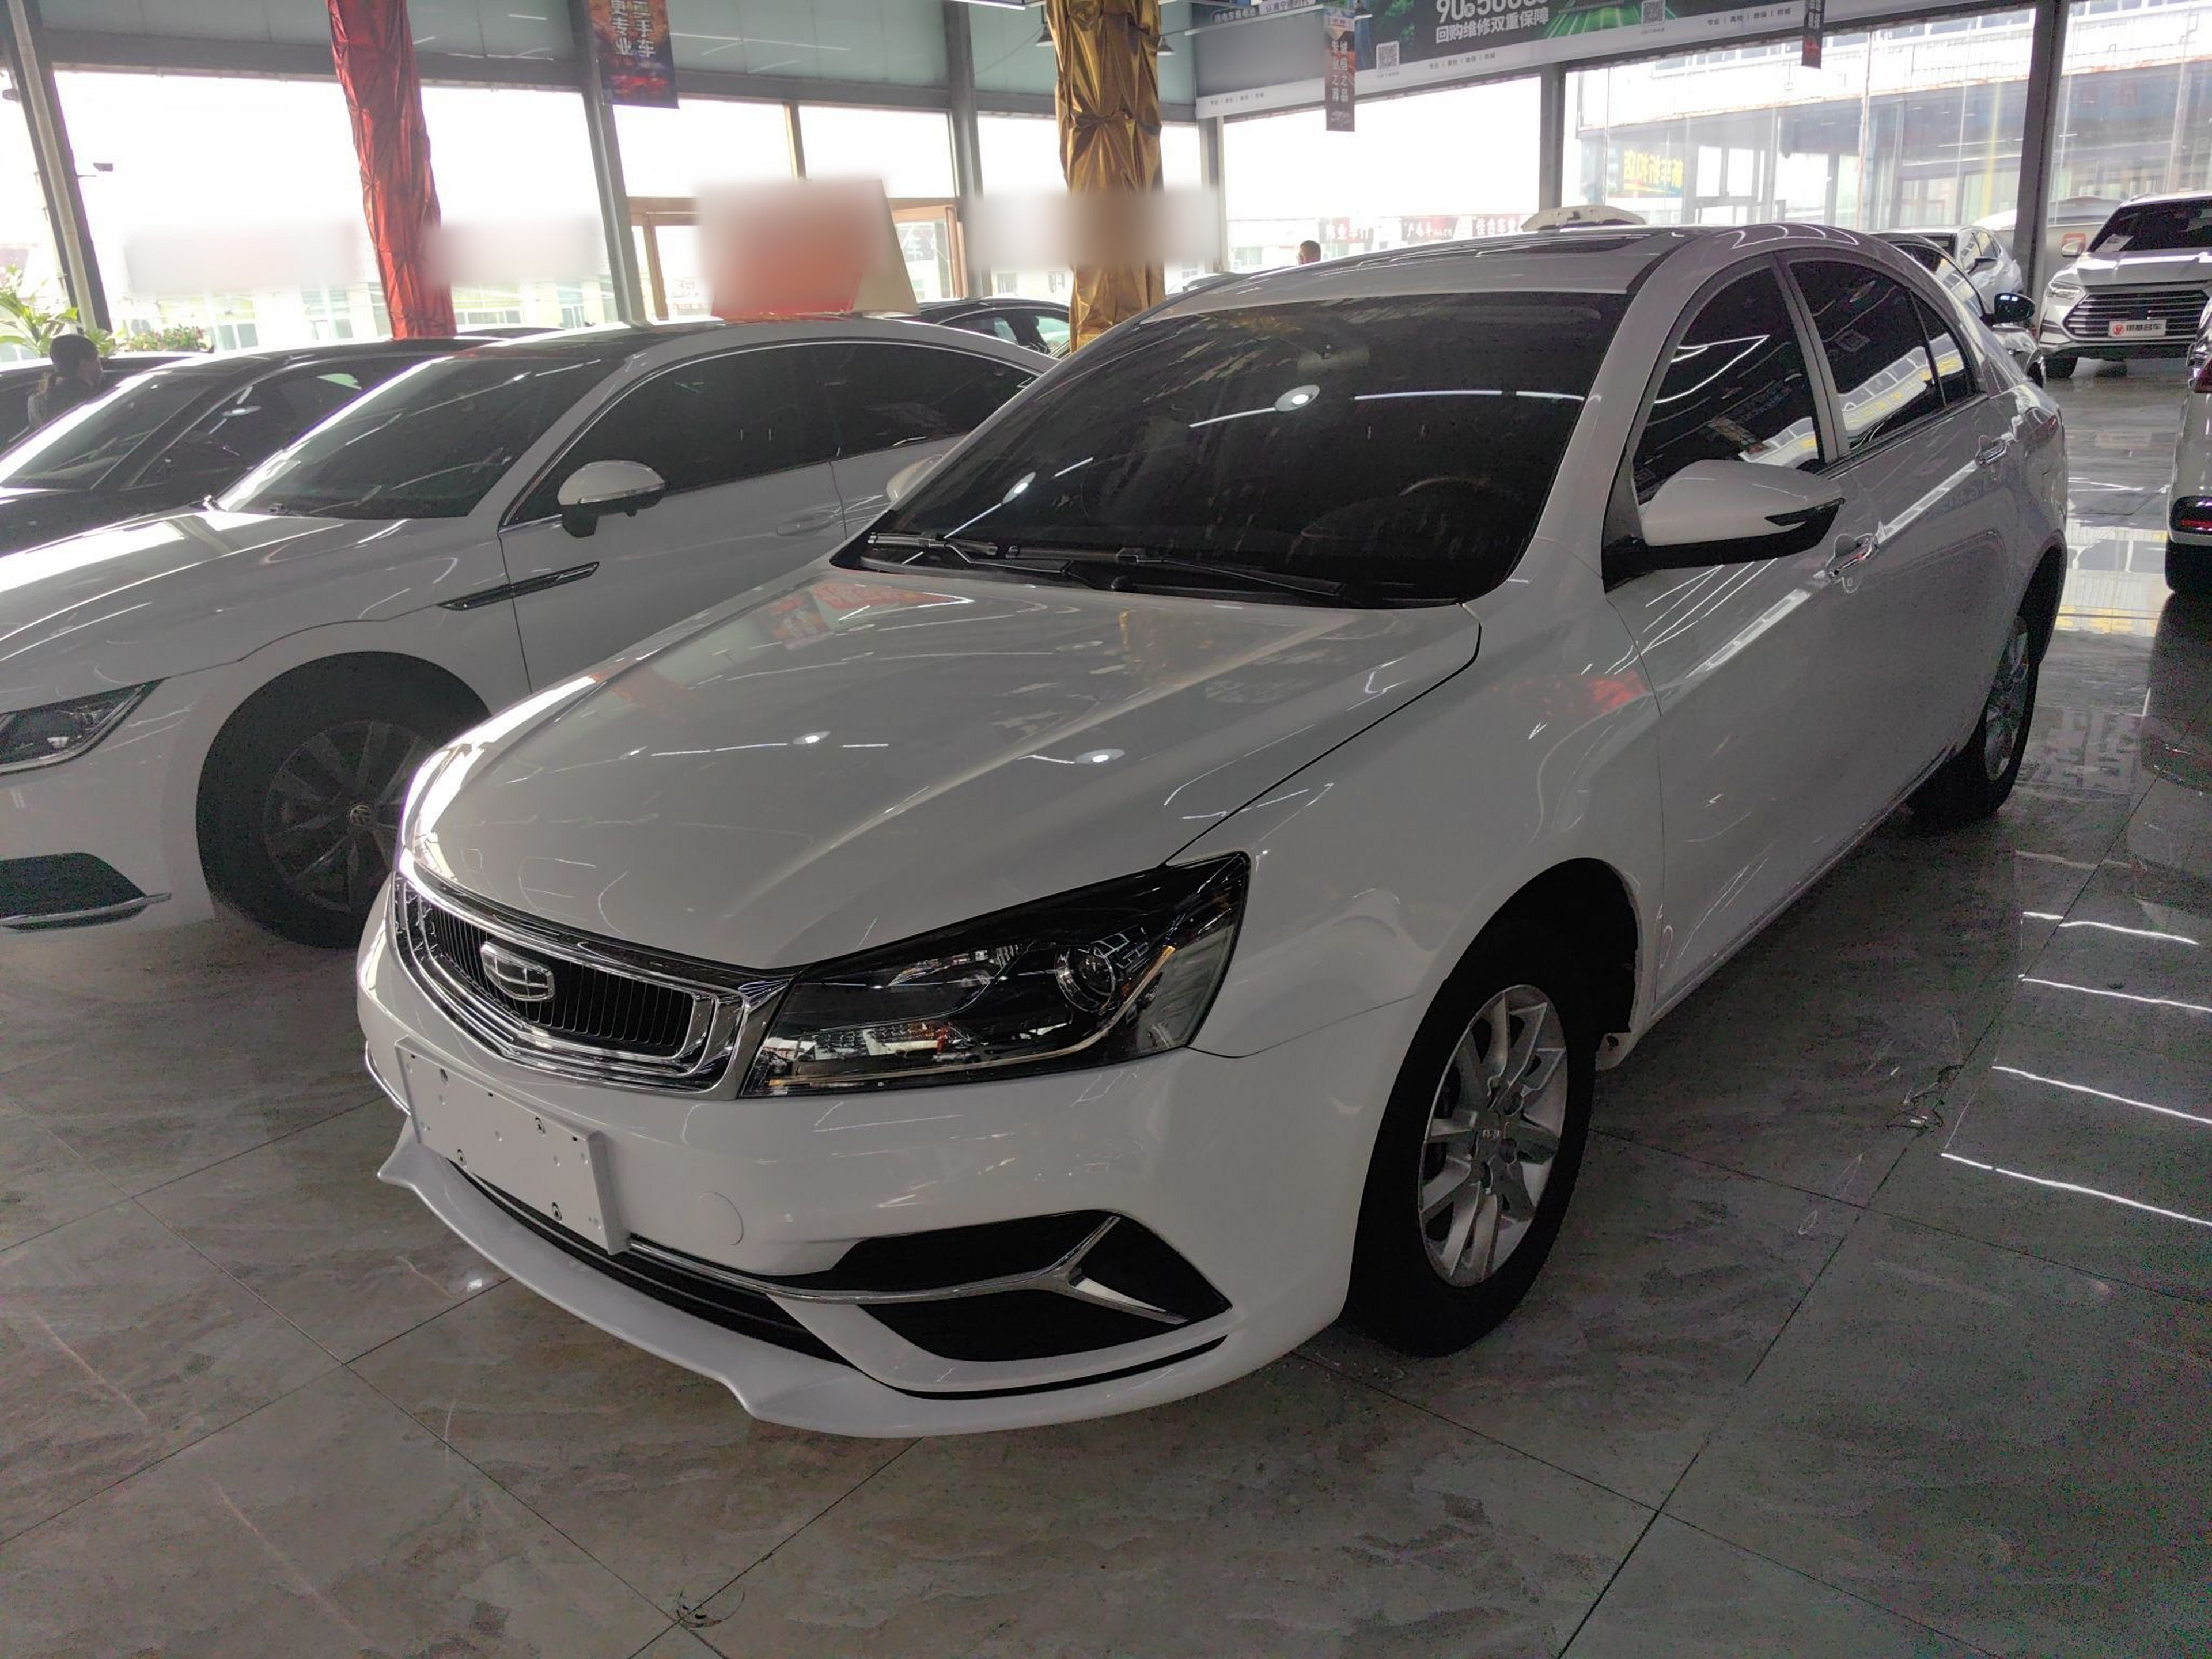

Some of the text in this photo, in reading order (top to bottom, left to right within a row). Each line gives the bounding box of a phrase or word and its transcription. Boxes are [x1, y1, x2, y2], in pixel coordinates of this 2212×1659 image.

[1436, 7, 1550, 43] 回购维修双重保障
